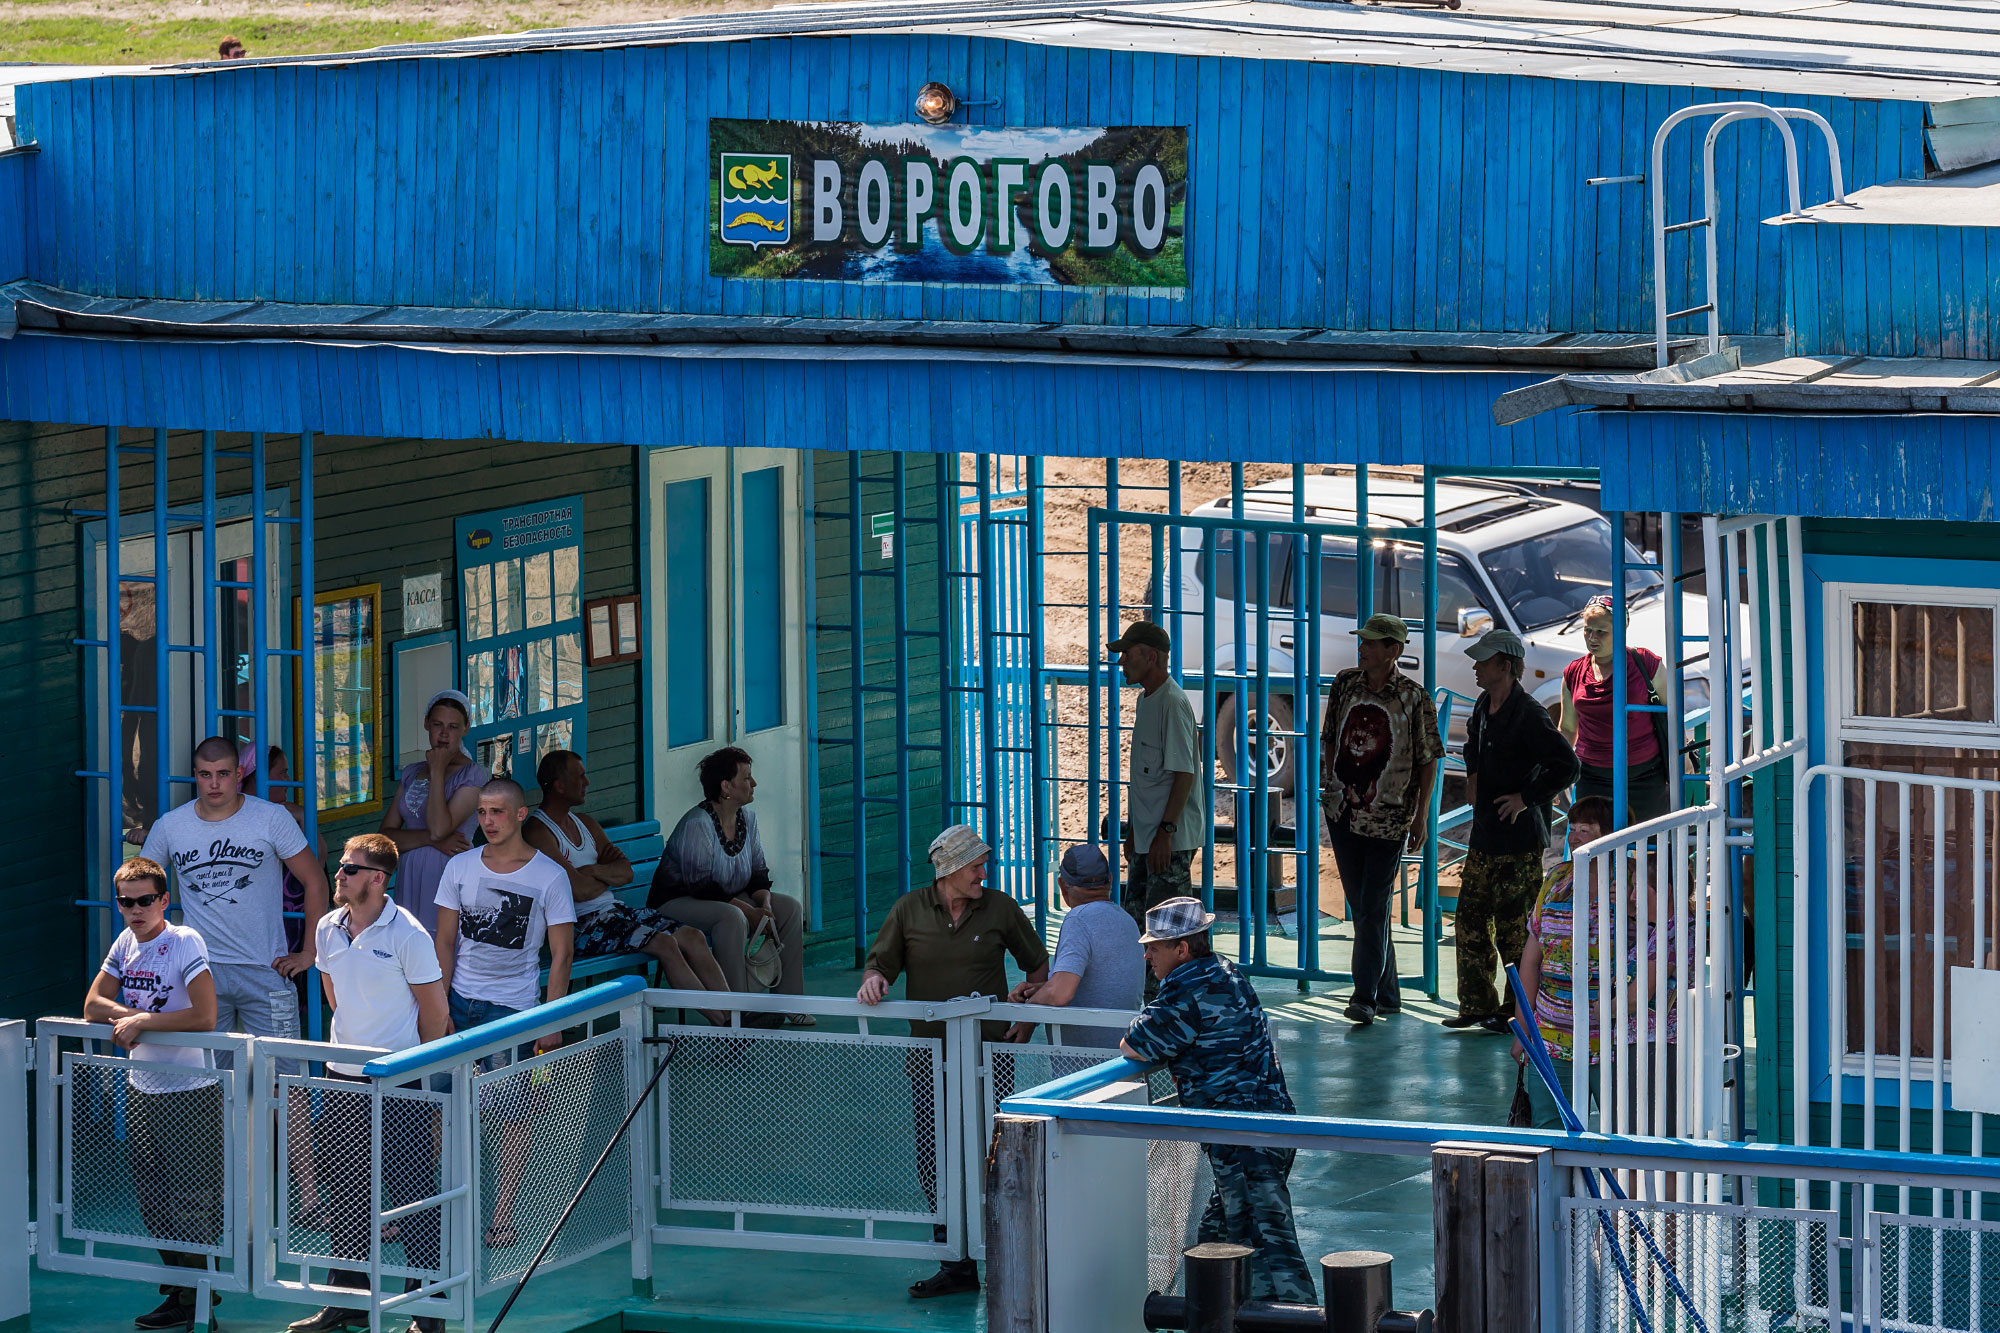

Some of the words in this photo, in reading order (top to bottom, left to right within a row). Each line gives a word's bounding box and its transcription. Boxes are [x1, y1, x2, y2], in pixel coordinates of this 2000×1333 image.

[811, 157, 1168, 252] ВОРОГОВО
[502, 507, 573, 531] ТРАНСПОРТНАЯ
[503, 525, 573, 549] БЕЗОПАСНОСТЬ
[407, 588, 437, 606] КАССА
[173, 849, 200, 868] One
[196, 870, 211, 880] and
[202, 881, 210, 889] be
